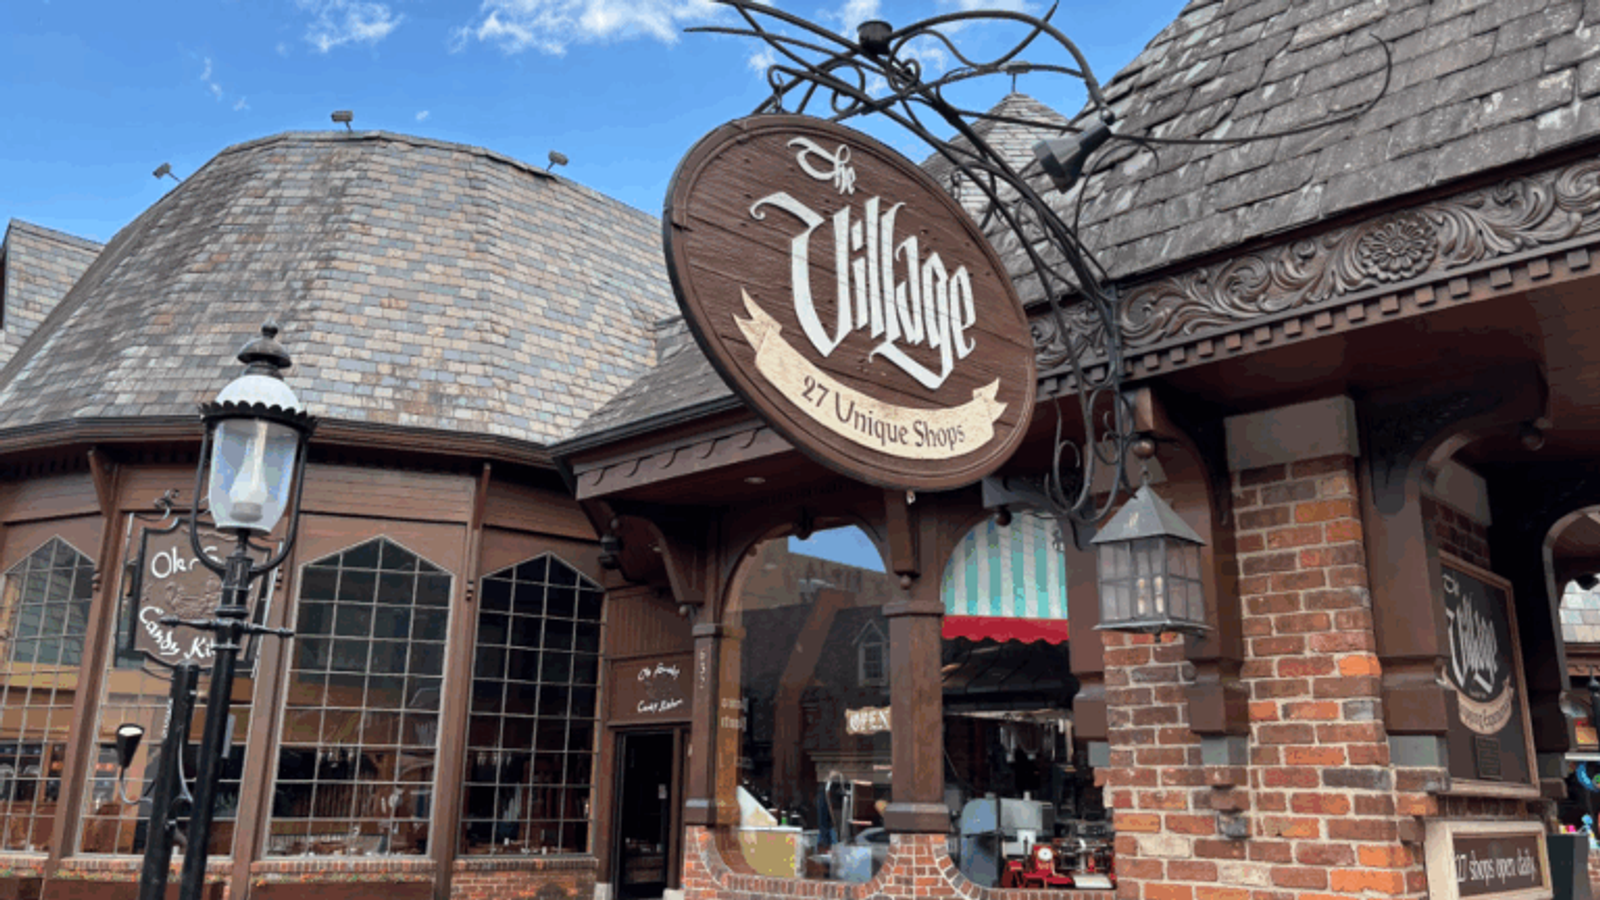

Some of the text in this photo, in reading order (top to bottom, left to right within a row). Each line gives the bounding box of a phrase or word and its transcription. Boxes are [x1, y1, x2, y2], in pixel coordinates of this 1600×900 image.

[787, 136, 856, 195] The
[750, 191, 976, 390] Village
[801, 375, 966, 450] 27 Unique Shops
[151, 546, 187, 578] Ole
[139, 605, 180, 656] Candy
[1469, 850, 1495, 886] shops
[1496, 858, 1516, 885] open
